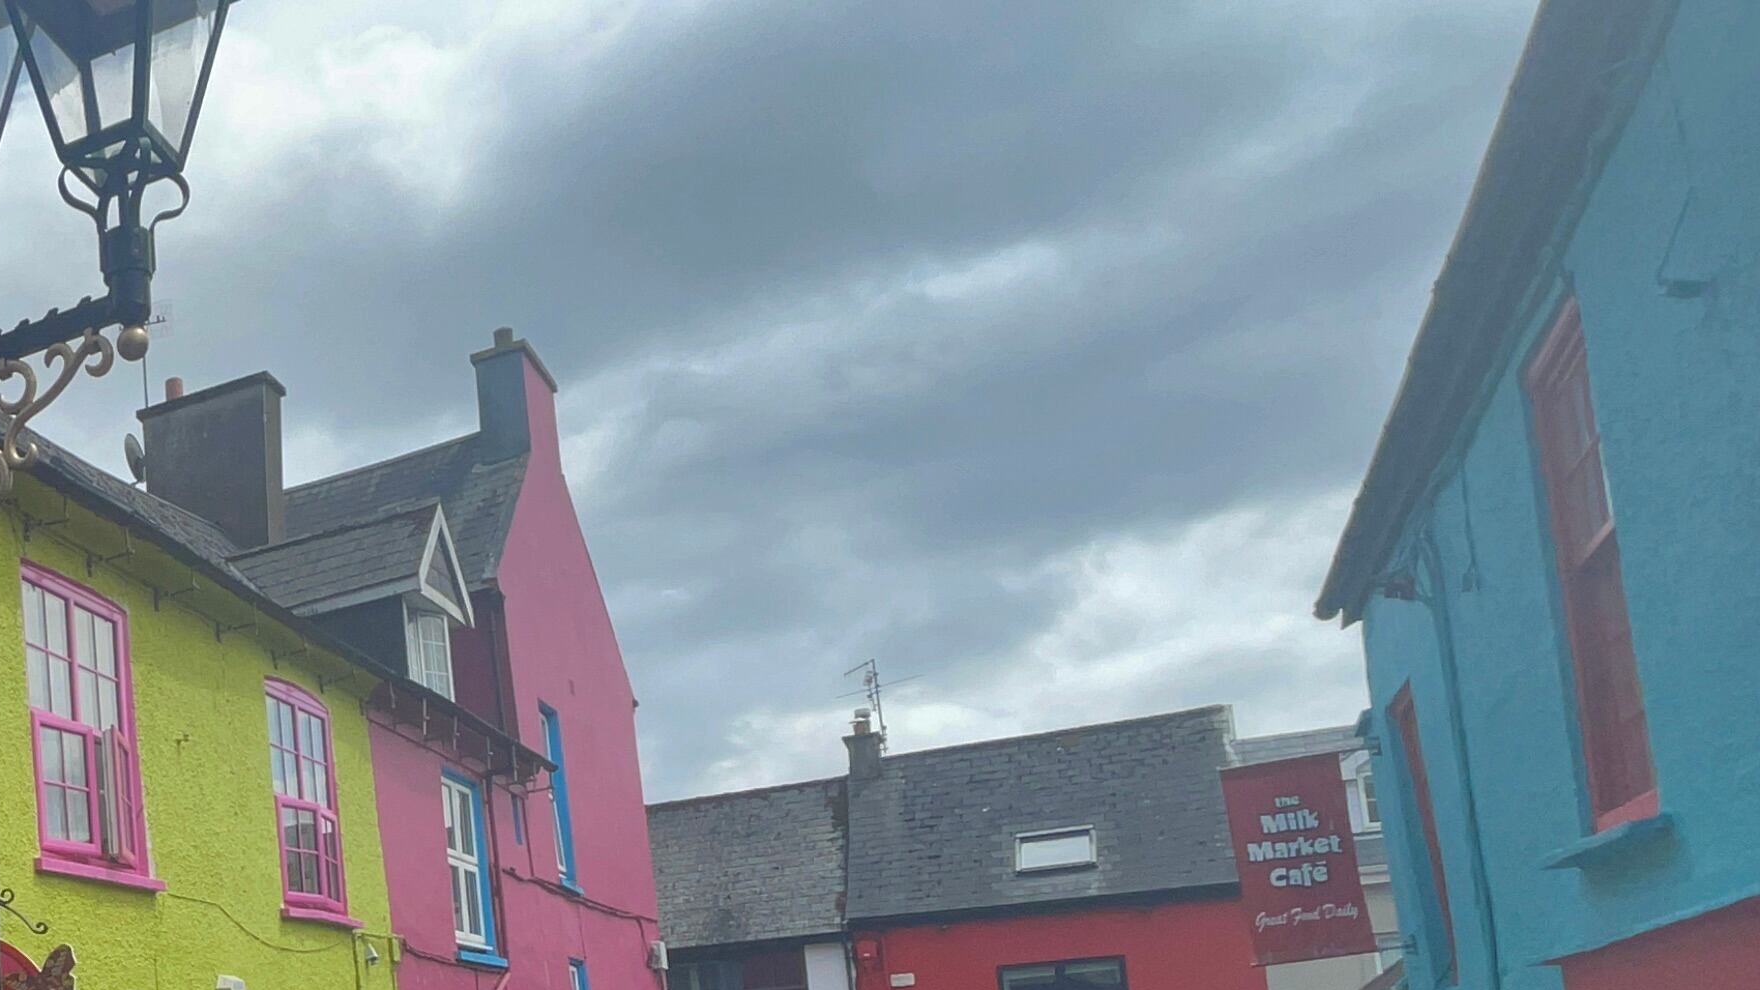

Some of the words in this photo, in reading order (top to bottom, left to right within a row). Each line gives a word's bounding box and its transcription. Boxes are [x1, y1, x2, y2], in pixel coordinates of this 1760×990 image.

[1260, 809, 1319, 834] Milk
[1247, 835, 1343, 862] Market
[1255, 911, 1288, 932] Great
[1322, 902, 1358, 920] Daily
